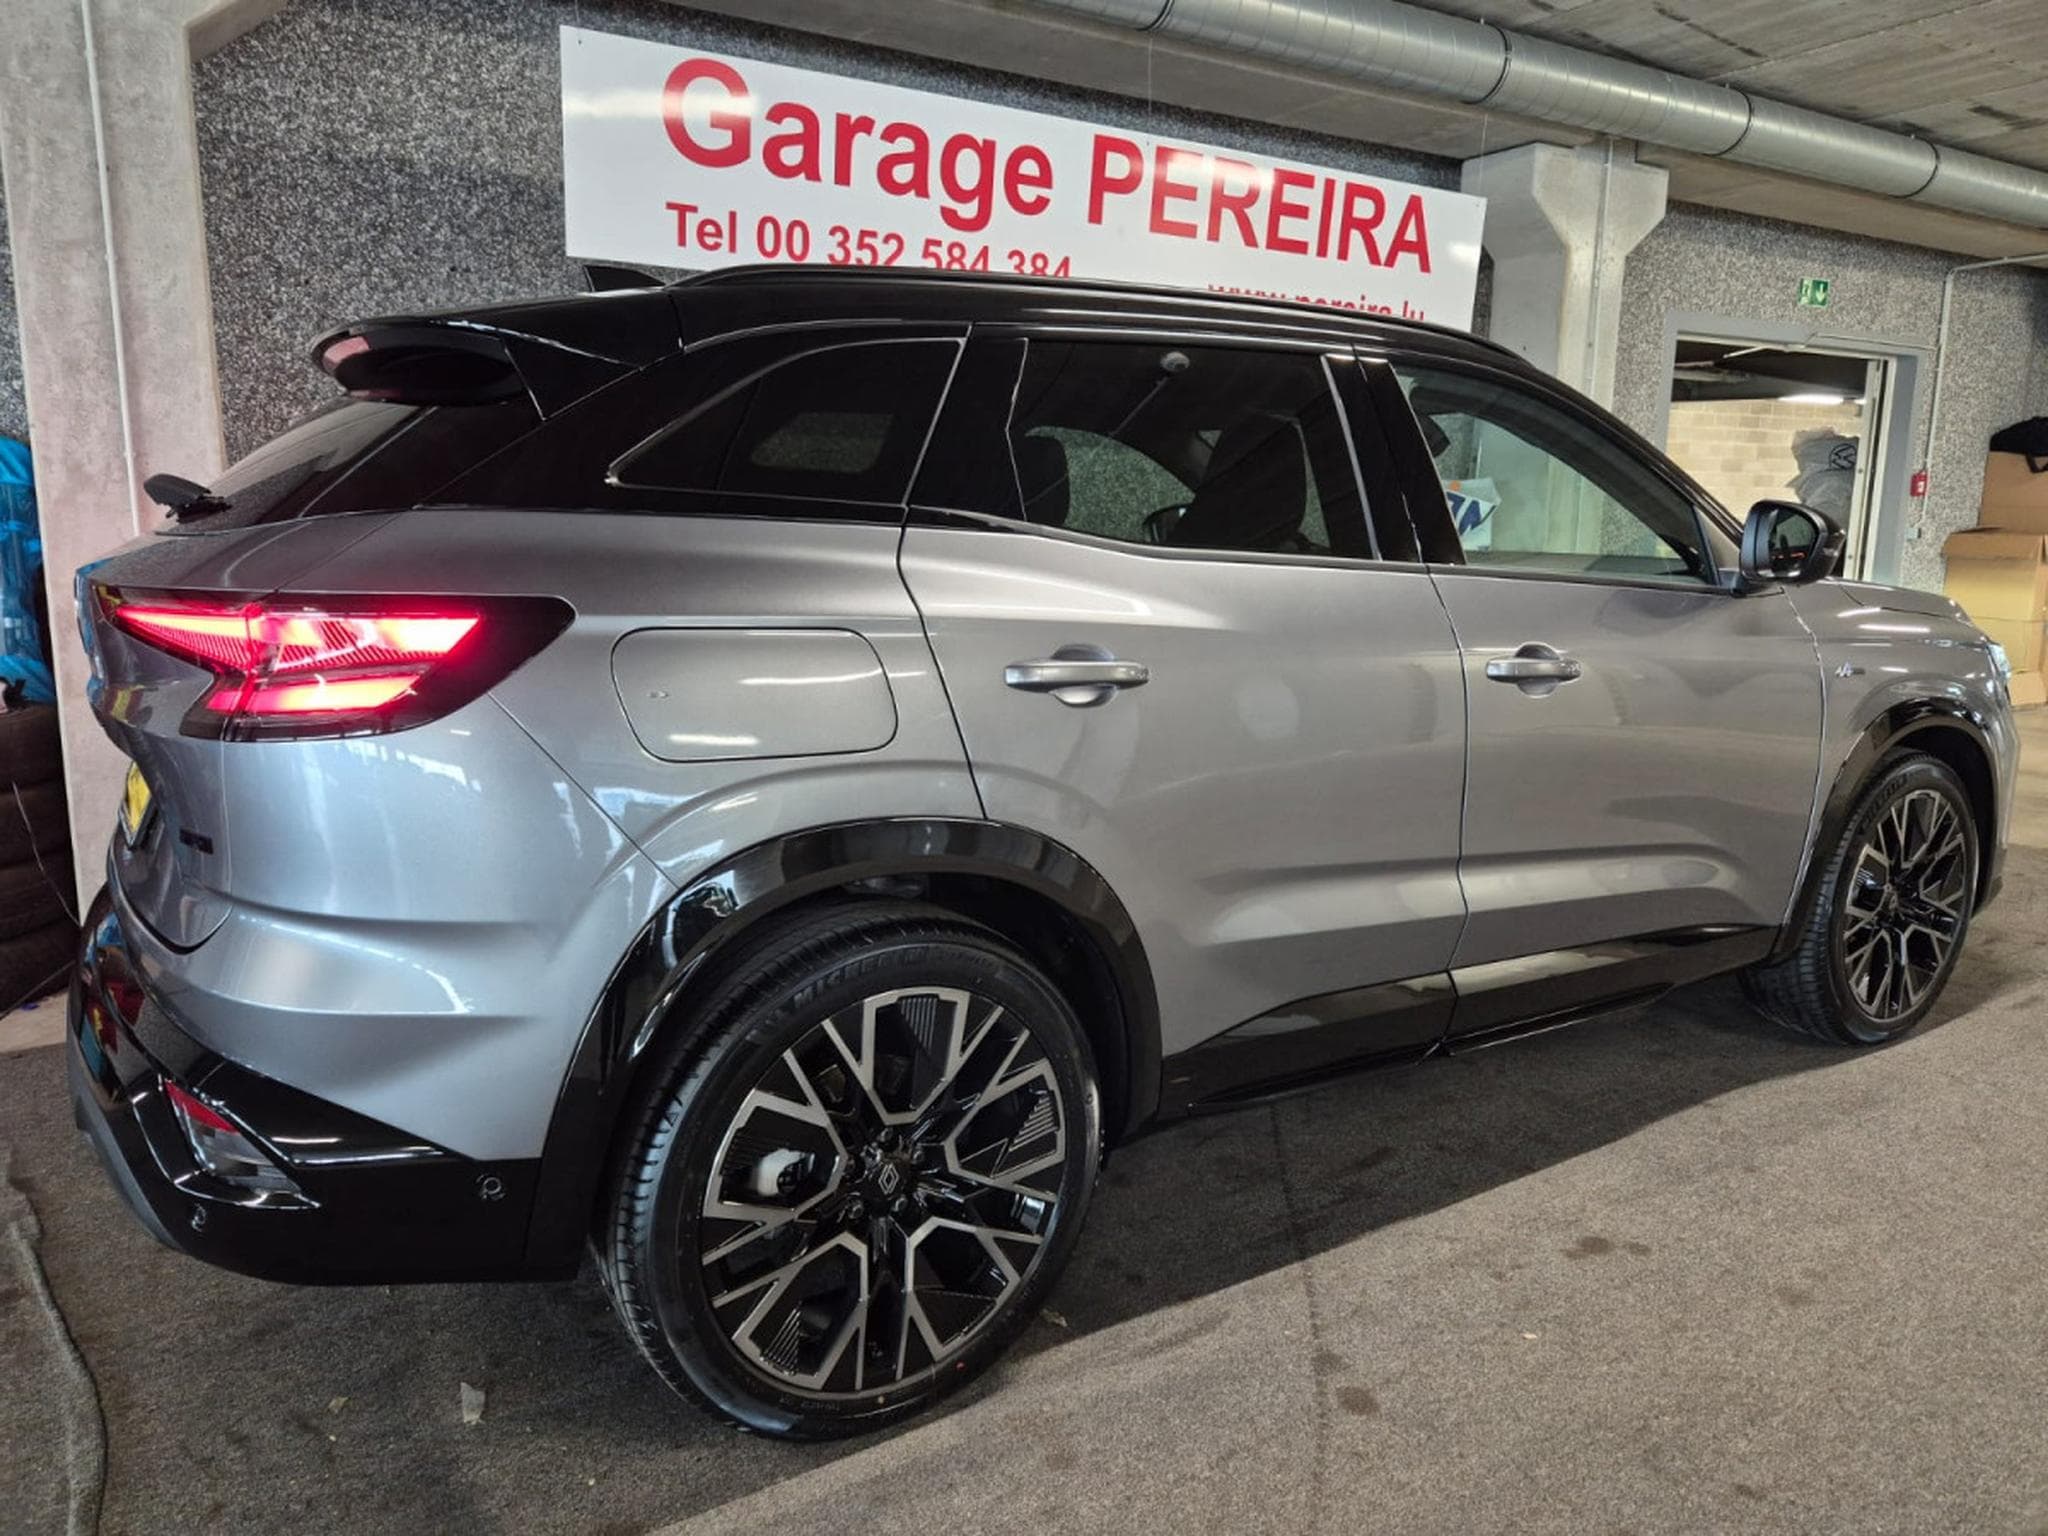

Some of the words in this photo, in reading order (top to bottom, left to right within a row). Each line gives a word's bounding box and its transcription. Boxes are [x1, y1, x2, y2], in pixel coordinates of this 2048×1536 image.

[662, 58, 1053, 232] Garage
[1088, 134, 1431, 273] PEREIRA
[666, 201, 737, 253] Tel
[757, 215, 810, 262] 00
[828, 225, 904, 266] 352
[922, 237, 989, 272] 584
[1008, 249, 1070, 279] 384
